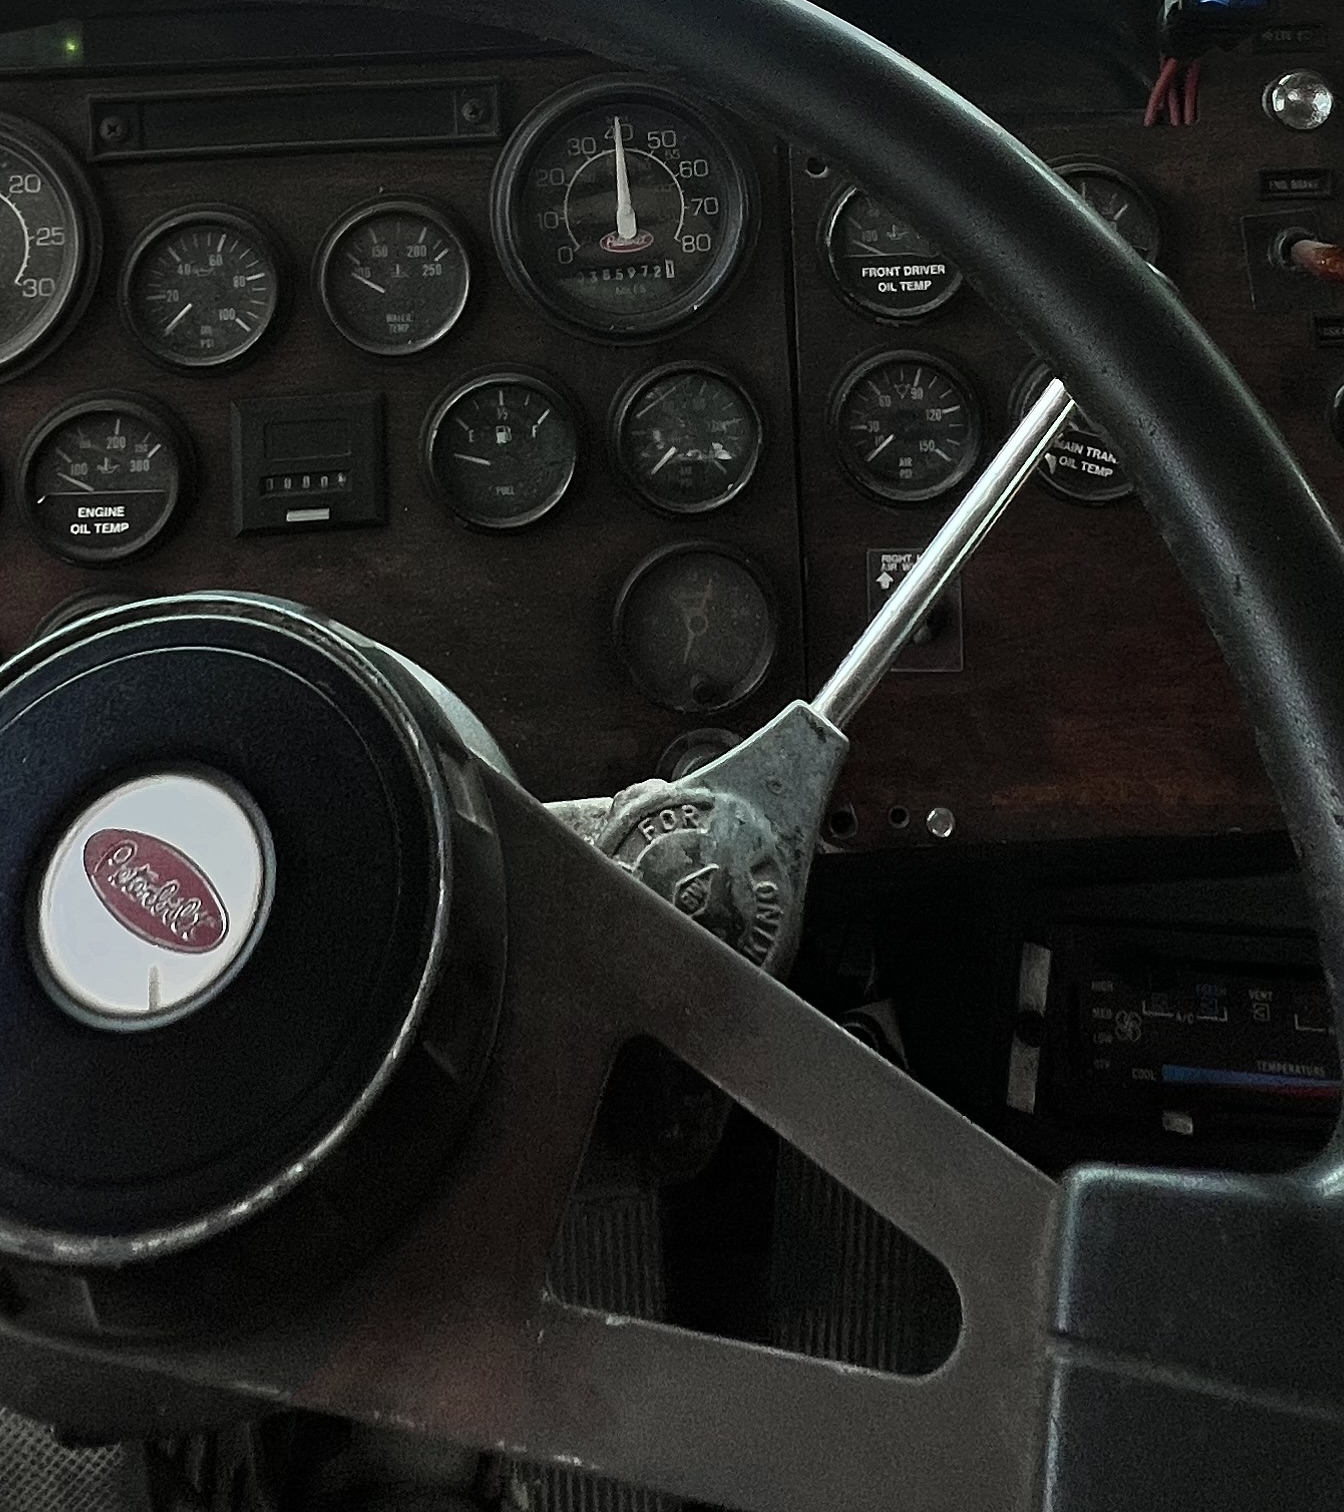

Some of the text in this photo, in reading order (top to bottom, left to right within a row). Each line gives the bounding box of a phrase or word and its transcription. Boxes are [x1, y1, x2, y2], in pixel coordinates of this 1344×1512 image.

[567, 137, 597, 156] 30
[647, 130, 677, 149] 50
[679, 159, 709, 178] 60
[9, 174, 42, 194] 20
[536, 167, 565, 187] 20
[691, 196, 719, 216] 70
[537, 210, 560, 230] 10
[35, 227, 66, 246] 25
[681, 233, 711, 253] 80
[371, 245, 388, 258] 150
[407, 245, 427, 258] 200
[557, 246, 574, 264] 0
[208, 253, 223, 267] 60
[177, 262, 191, 276] 40
[422, 263, 442, 276] 250
[862, 264, 946, 277] FRONT DRIVER
[21, 277, 56, 298] 30
[233, 274, 246, 288] 80
[878, 280, 932, 293] OIL TEMP
[167, 289, 179, 302] 20
[219, 307, 235, 321] 100
[910, 388, 924, 400] 90
[925, 408, 943, 422] 120
[106, 436, 126, 449] 200
[919, 439, 936, 452] 150
[70, 462, 88, 476] 100
[1059, 455, 1113, 477] OIL TEMP
[78, 506, 125, 518] ENGINE
[70, 522, 129, 534] OIL TEMP
[881, 554, 912, 563] RIGHT
[1249, 989, 1274, 1001] VENT
[1256, 1060, 1326, 1076] TEMPERATURE
